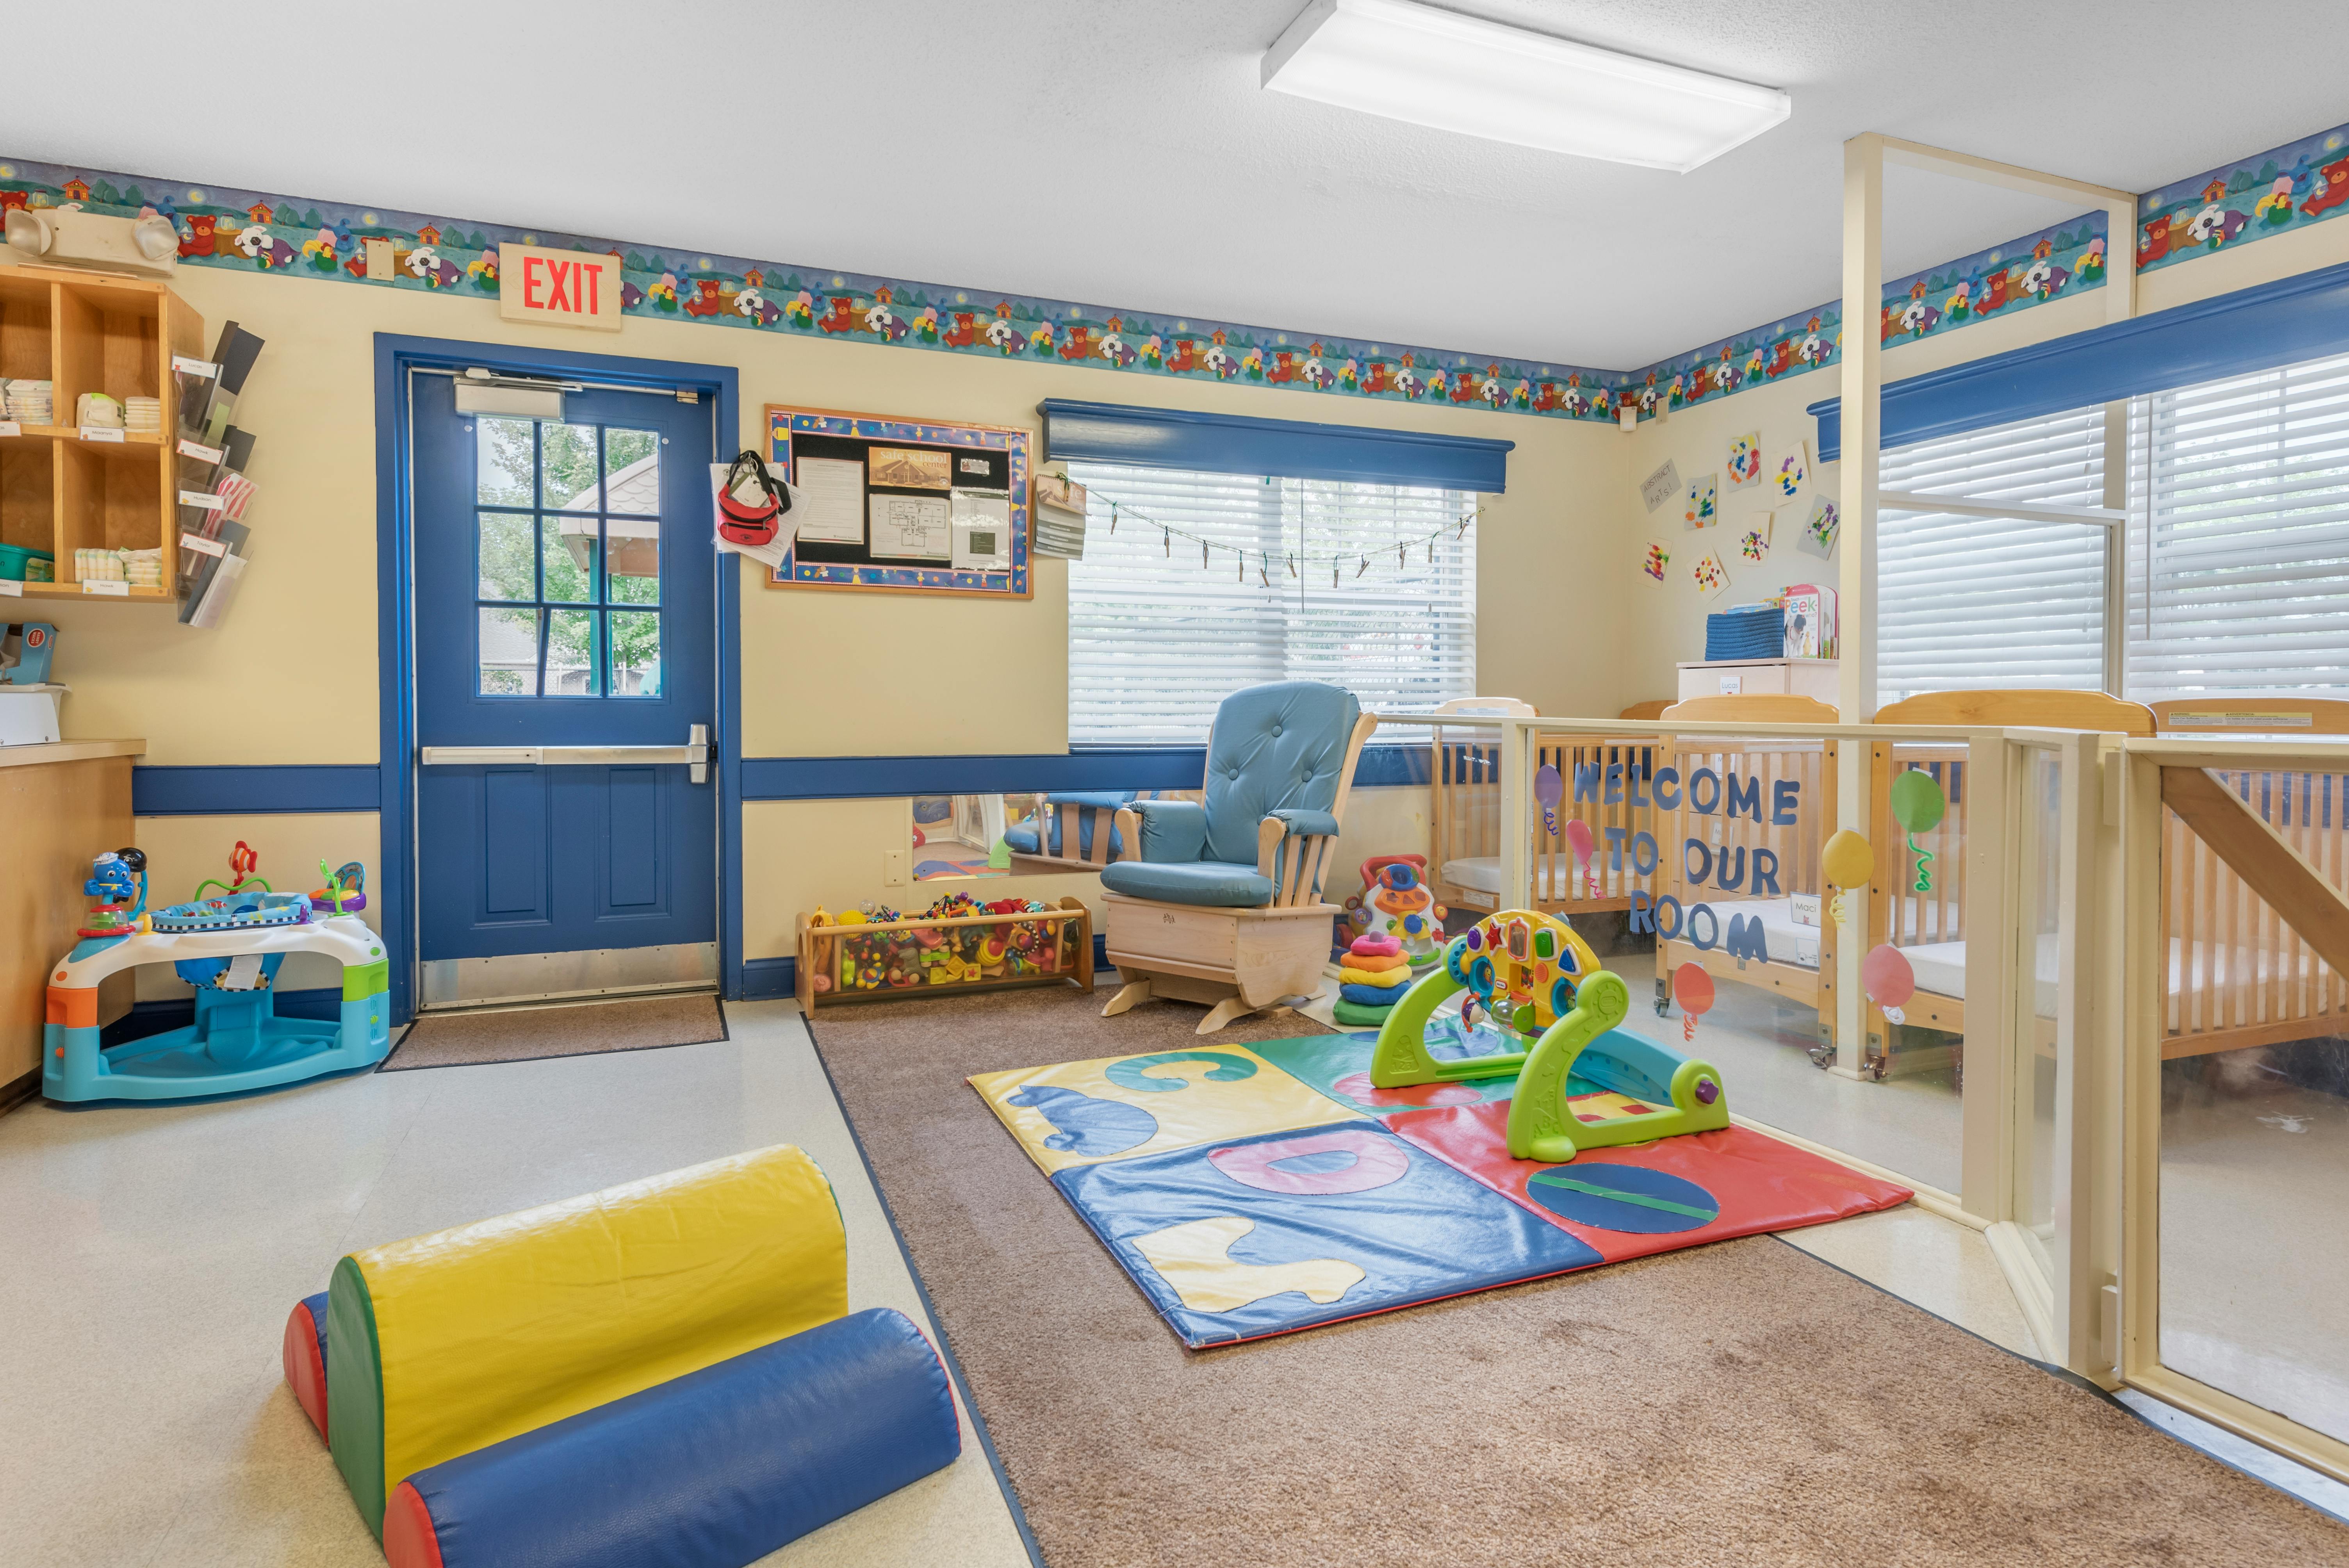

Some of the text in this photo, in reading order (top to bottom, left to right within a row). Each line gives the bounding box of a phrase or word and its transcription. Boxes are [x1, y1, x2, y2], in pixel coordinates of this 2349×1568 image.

[524, 257, 603, 315] EXIT
[880, 450, 947, 464] safe school
[1644, 465, 1670, 493] ABSTRACT
[1057, 485, 1082, 499] sfe
[1650, 482, 1672, 504] ARTS!
[1785, 597, 1818, 614] Peek-
[1574, 761, 1800, 826] WELCOME
[1605, 827, 1782, 896] TO OUR
[1795, 902, 1817, 913] Maci
[1629, 890, 1769, 964] ROOM
